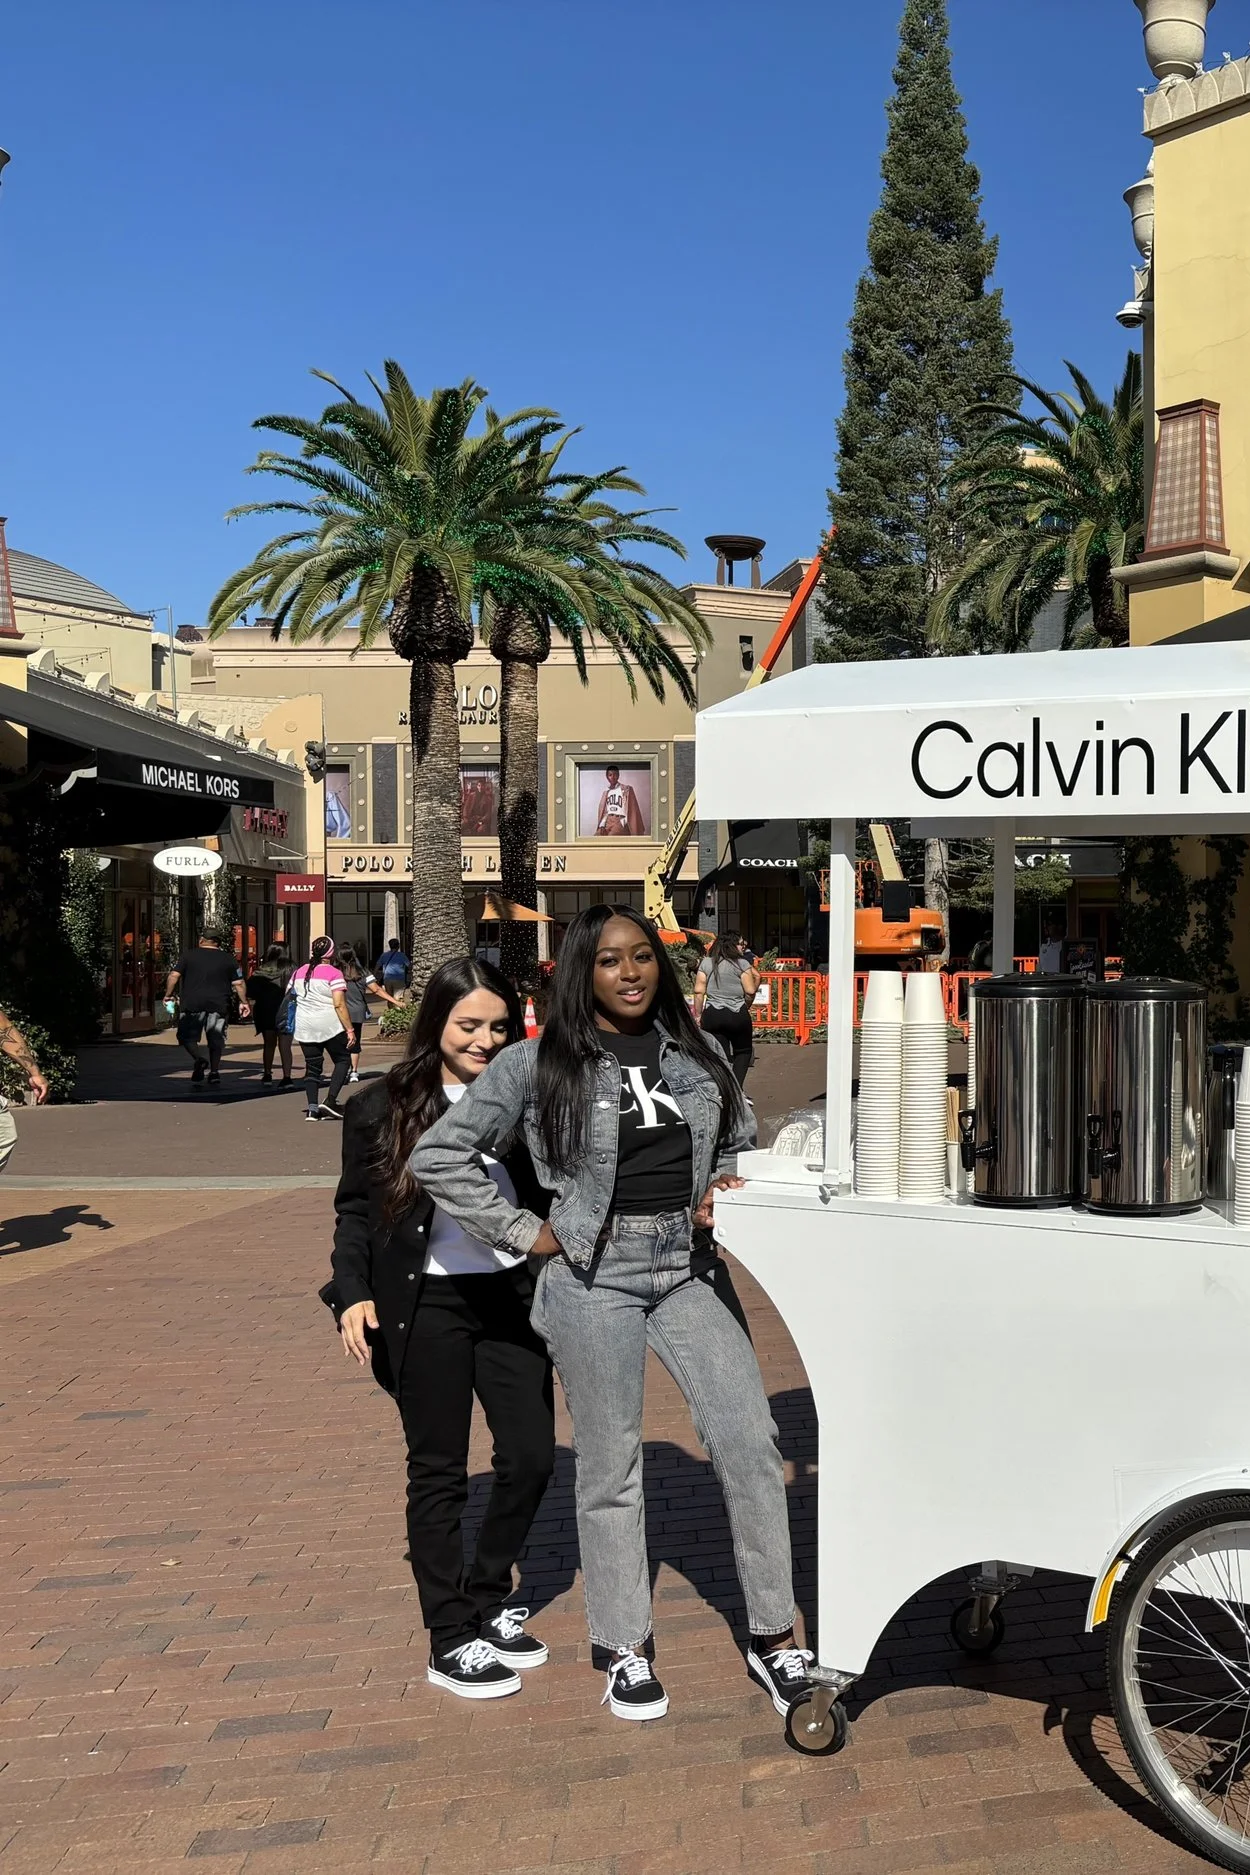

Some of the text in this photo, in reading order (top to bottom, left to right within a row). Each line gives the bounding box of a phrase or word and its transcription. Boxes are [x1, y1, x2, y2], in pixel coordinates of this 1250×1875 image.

[454, 685, 498, 711] LO
[459, 711, 498, 725] LAUR
[911, 716, 1155, 800] Calvin
[141, 763, 240, 799] MICHAEL KORS
[165, 856, 210, 866] FURLA
[341, 855, 394, 872] POLO
[739, 858, 798, 867] COACH
